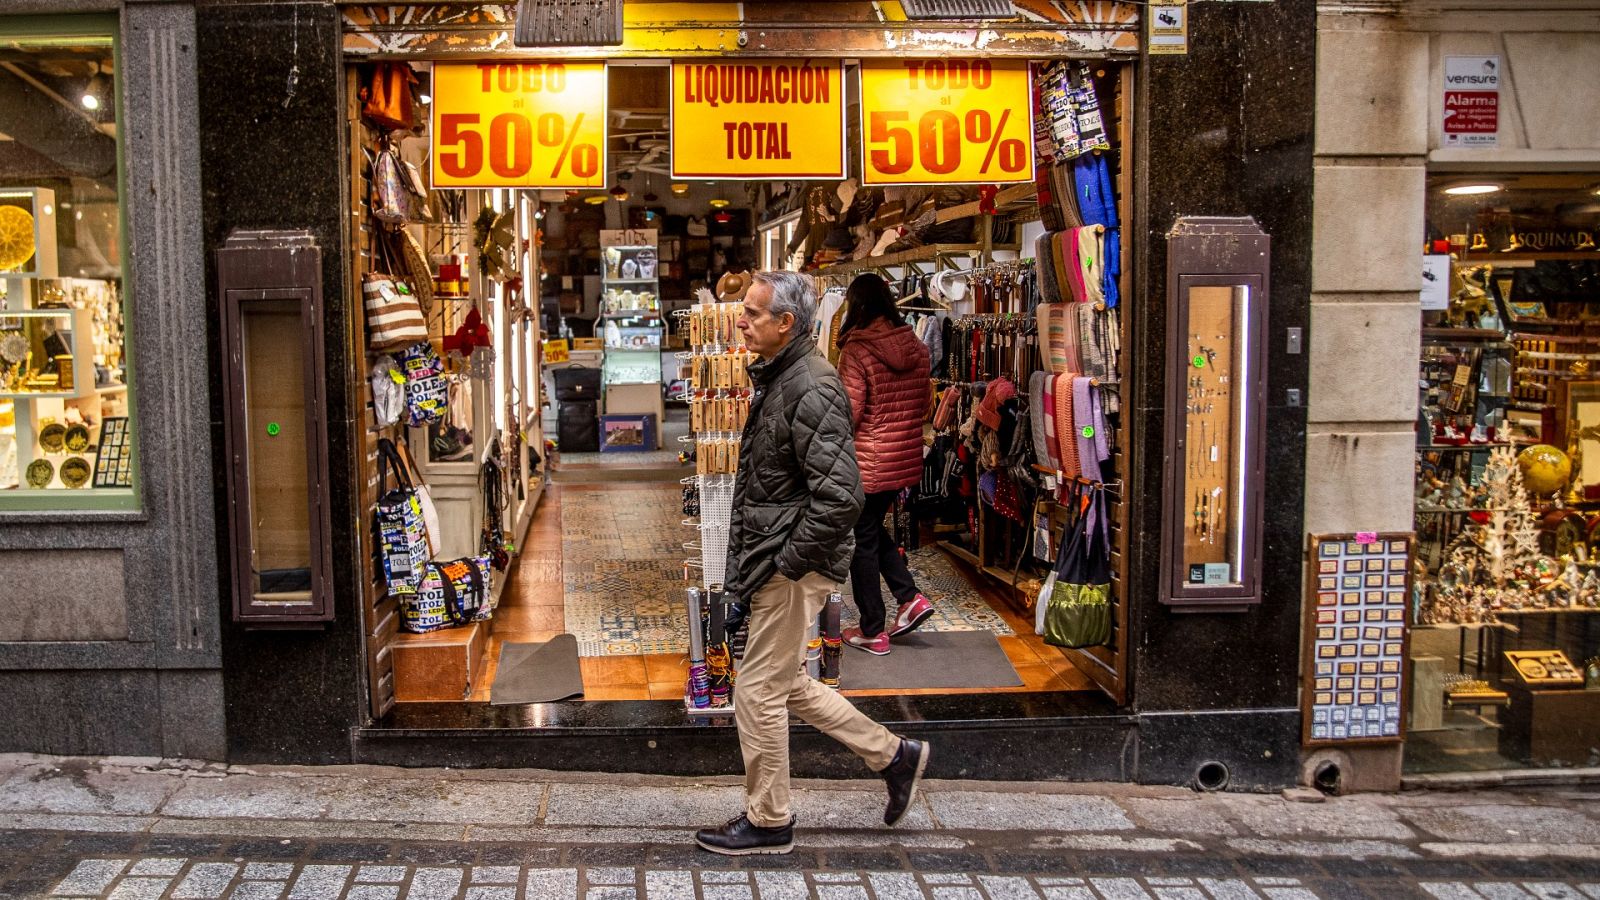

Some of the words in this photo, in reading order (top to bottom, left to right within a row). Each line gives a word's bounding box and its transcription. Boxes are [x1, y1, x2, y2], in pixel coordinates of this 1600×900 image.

[477, 63, 567, 93] TODO
[685, 59, 829, 107] LIQUIDACIÓN
[904, 59, 992, 90] TODO
[1447, 75, 1497, 84] verisure
[513, 98, 524, 108] al
[940, 96, 951, 105] al
[1446, 94, 1497, 106] Alarma
[440, 112, 599, 178] 50%
[724, 122, 791, 160] TOTAL
[870, 109, 1026, 174] 50%
[545, 350, 569, 362] 50%
